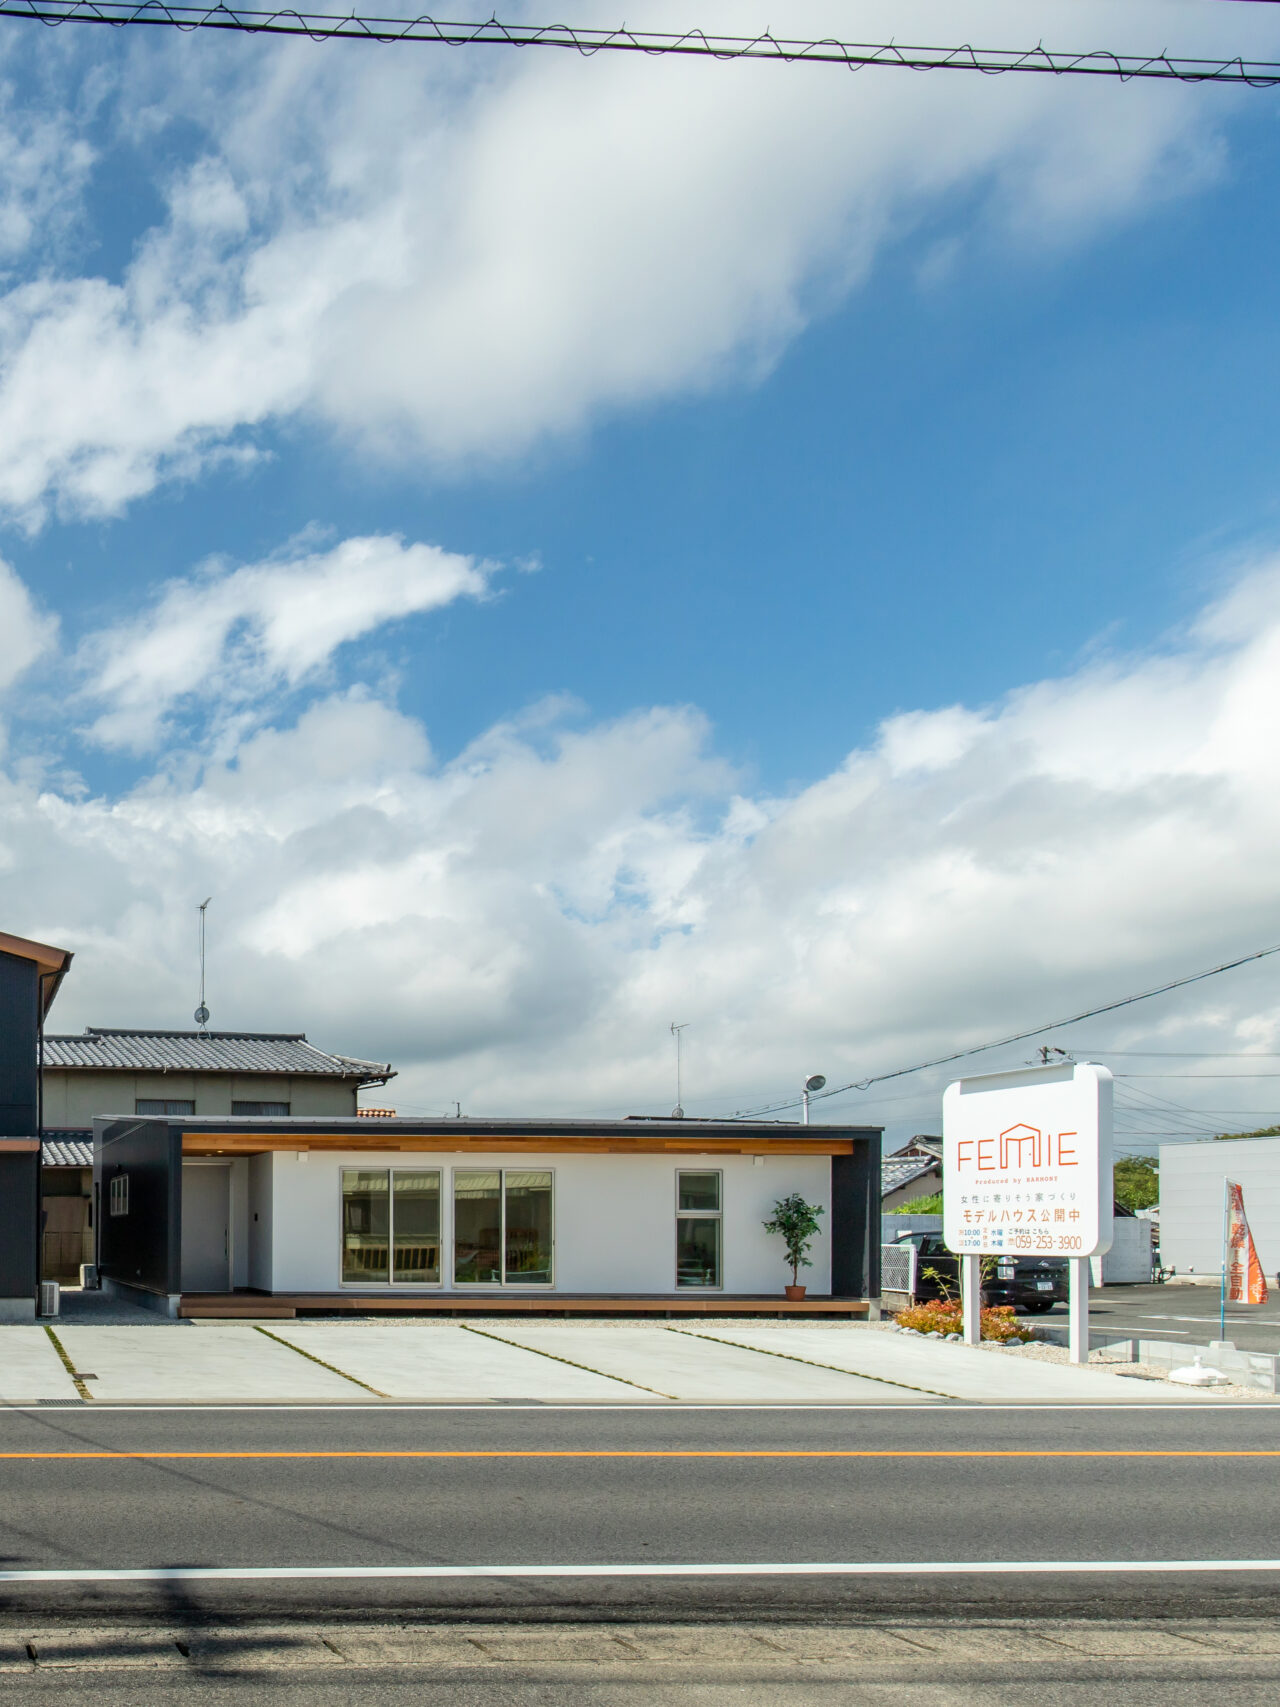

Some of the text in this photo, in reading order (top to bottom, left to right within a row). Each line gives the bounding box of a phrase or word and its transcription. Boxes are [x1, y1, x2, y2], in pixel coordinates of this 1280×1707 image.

[958, 1123, 1078, 1172] FEMIE
[960, 1192, 1076, 1204] 女性に寄りそう家づくり
[963, 1208, 1080, 1223] モデルハウス公開中
[1015, 1235, 1082, 1250] 059-253-3900
